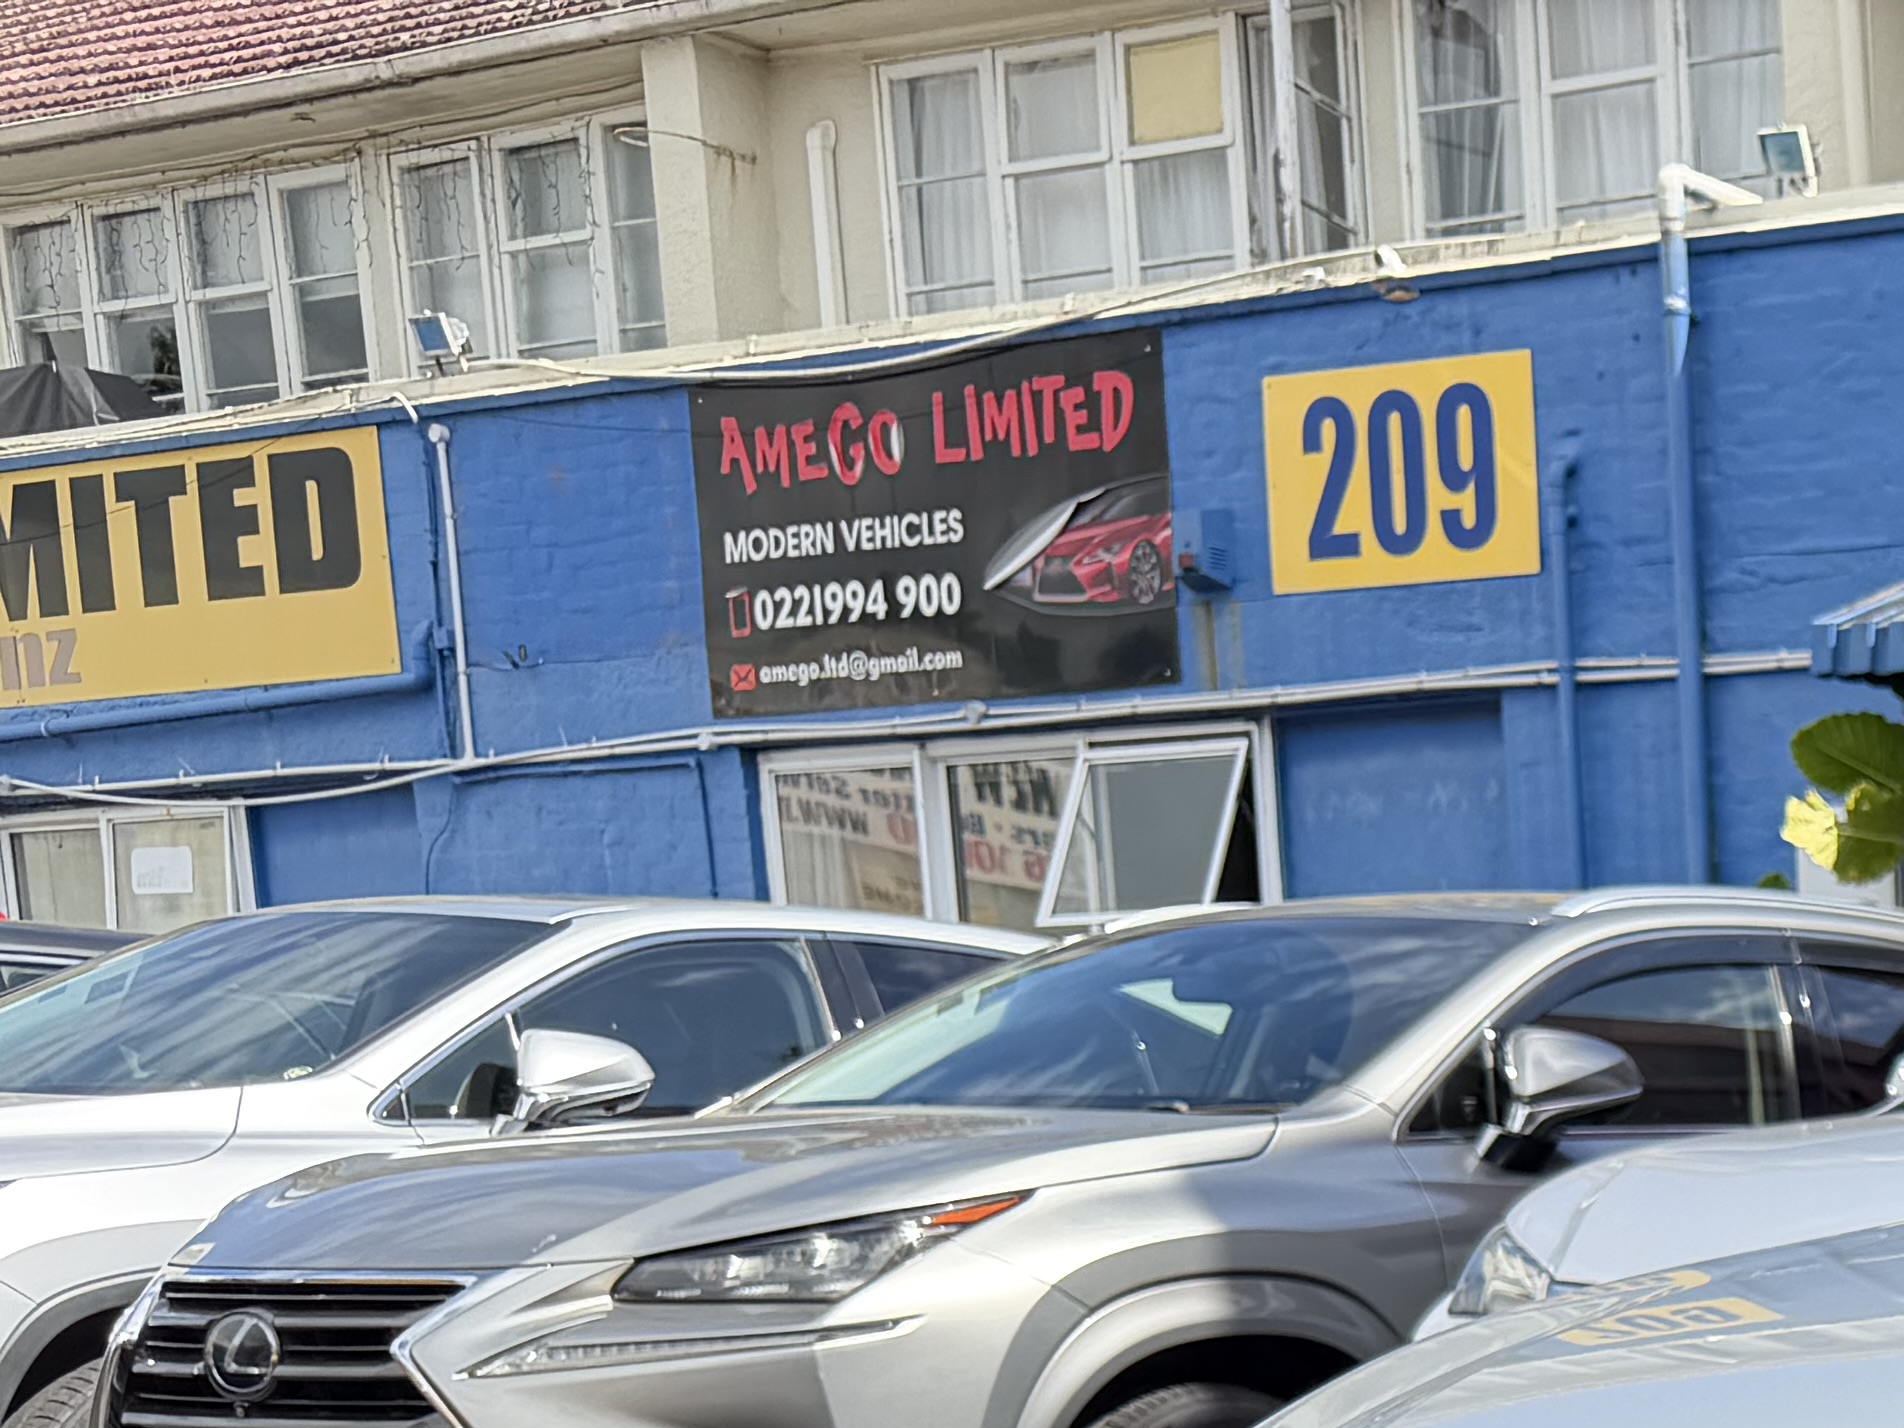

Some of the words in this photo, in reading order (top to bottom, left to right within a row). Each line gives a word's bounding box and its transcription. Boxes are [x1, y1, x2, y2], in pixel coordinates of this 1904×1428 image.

[932, 370, 1135, 464] LIMITED
[1302, 382, 1496, 561] 209
[723, 524, 835, 564] MODERN
[839, 508, 965, 552] VEHICLES
[754, 578, 888, 631] 0221994
[895, 572, 961, 619] 900
